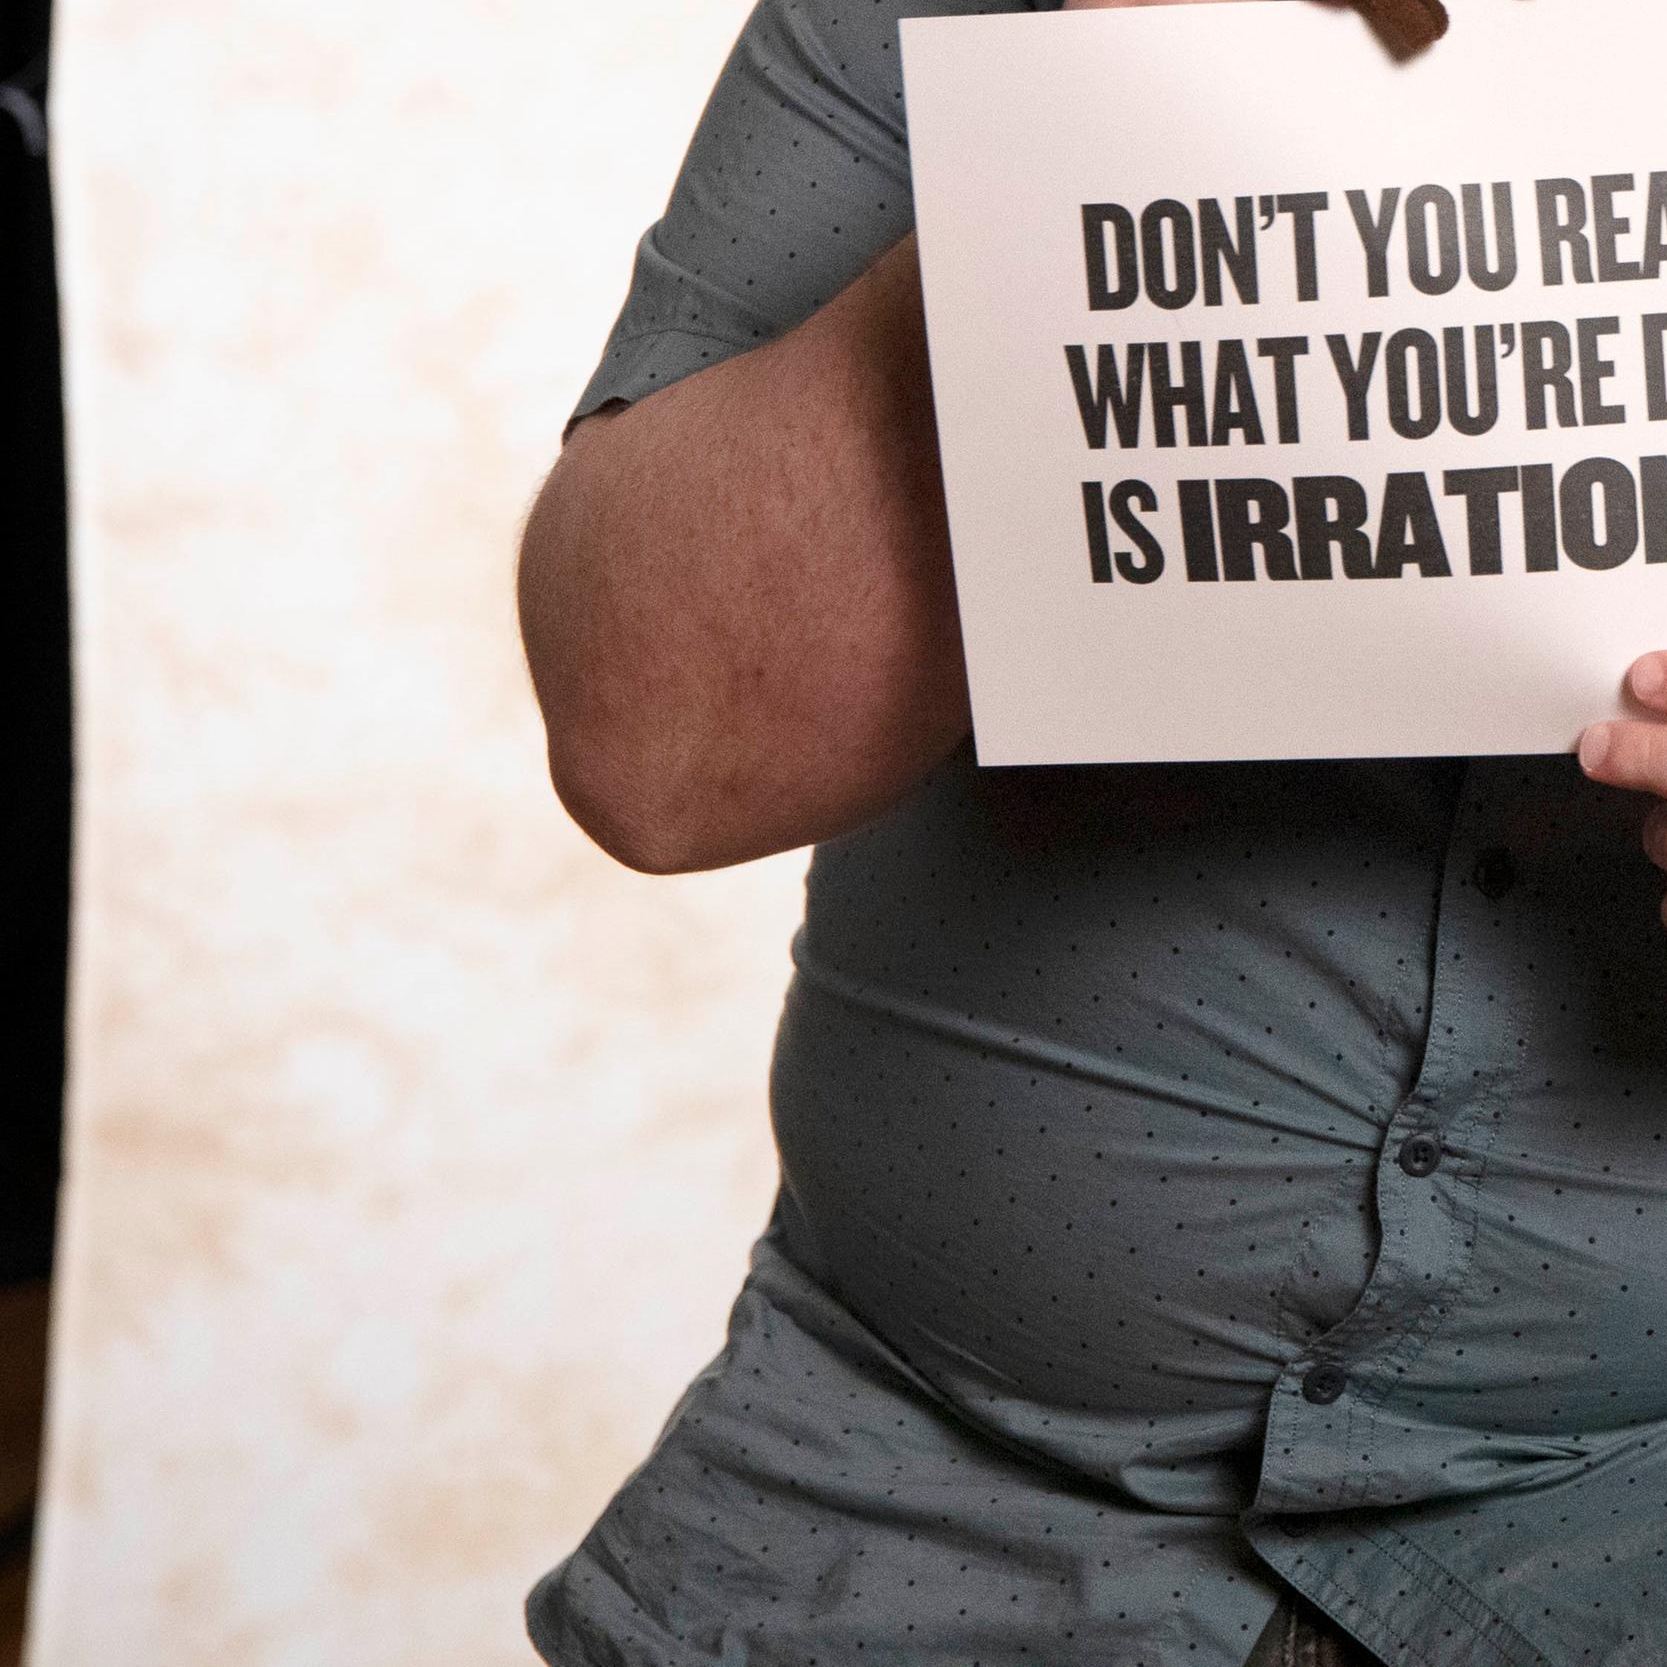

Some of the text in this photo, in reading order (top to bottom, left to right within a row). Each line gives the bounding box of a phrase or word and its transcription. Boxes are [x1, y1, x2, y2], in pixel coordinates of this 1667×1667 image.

[1082, 192, 1328, 311] DON'T
[1346, 182, 1517, 297] YOU
[1064, 336, 1308, 449] WHAT
[1325, 317, 1626, 440] YOU'RE
[1081, 479, 1166, 584] IS
